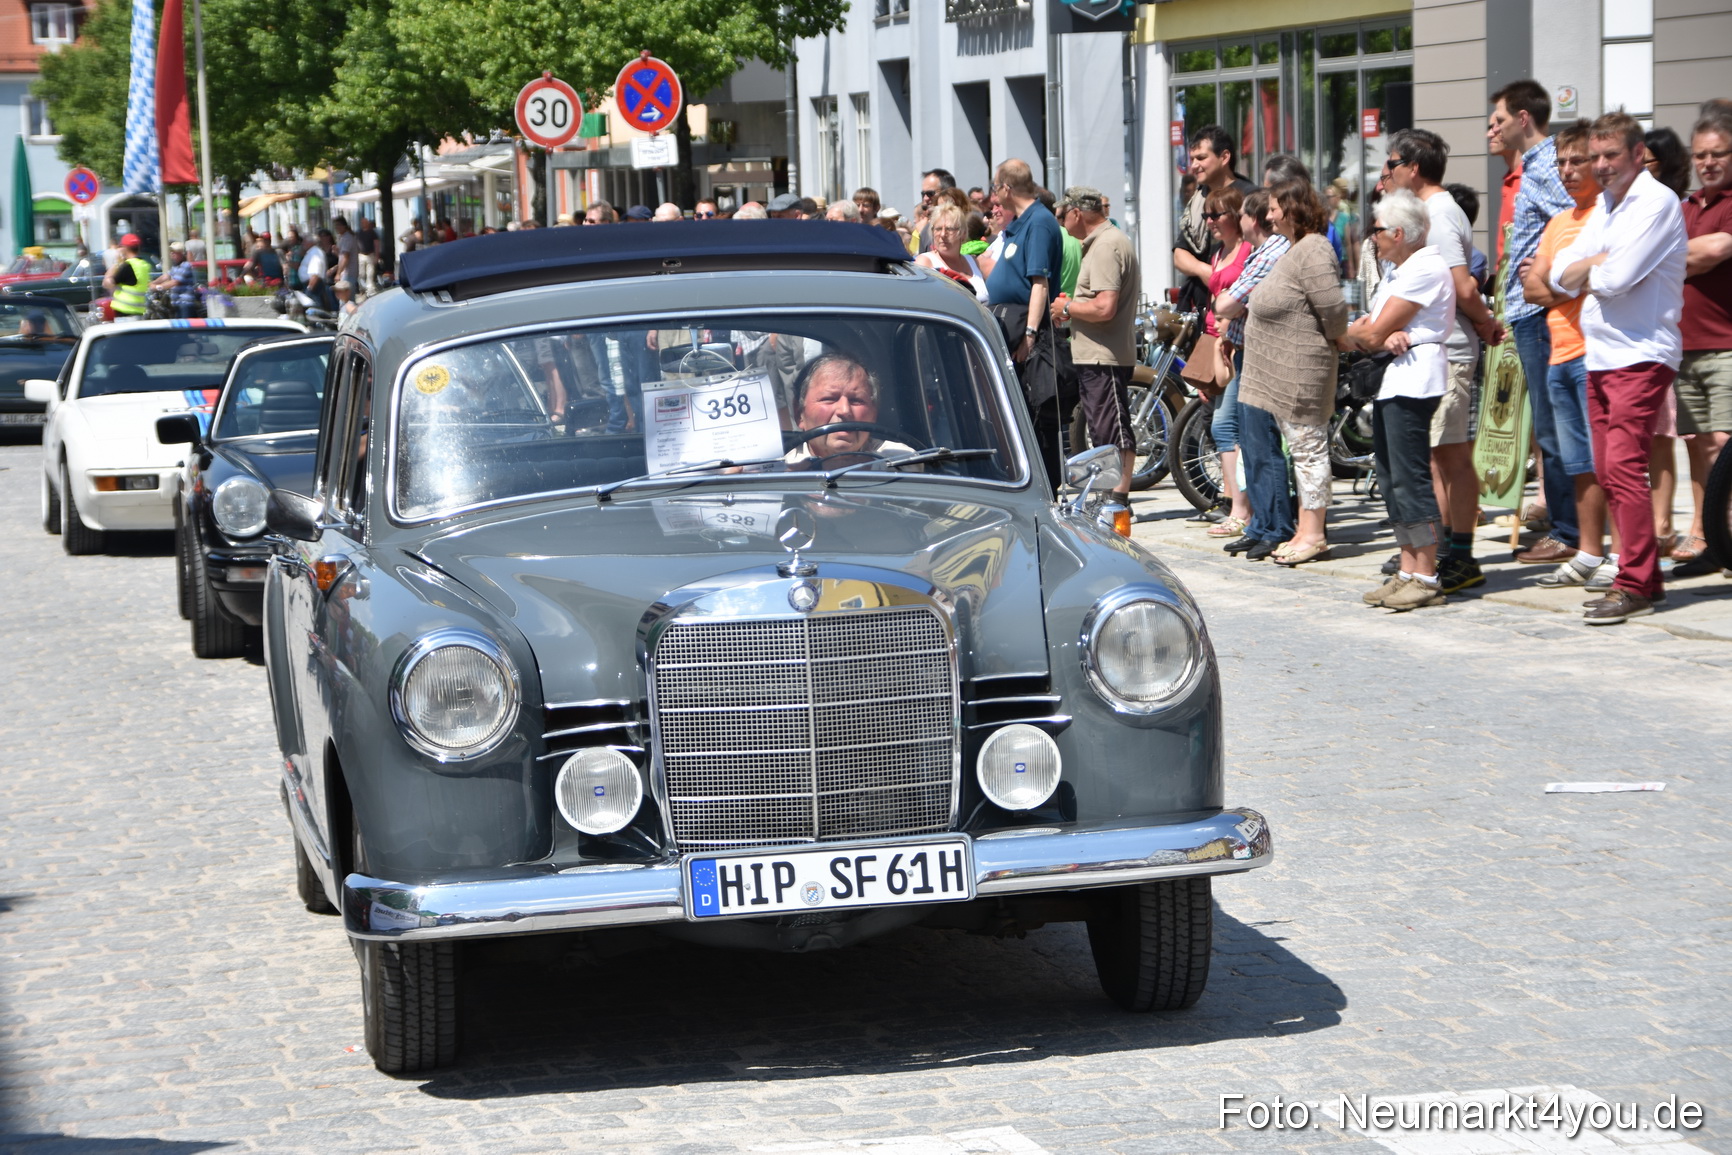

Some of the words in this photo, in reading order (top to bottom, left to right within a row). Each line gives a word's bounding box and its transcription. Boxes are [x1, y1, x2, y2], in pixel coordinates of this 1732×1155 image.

[530, 96, 567, 128] 30
[708, 394, 751, 420] 358
[719, 861, 796, 907] HIP
[701, 894, 712, 906] D
